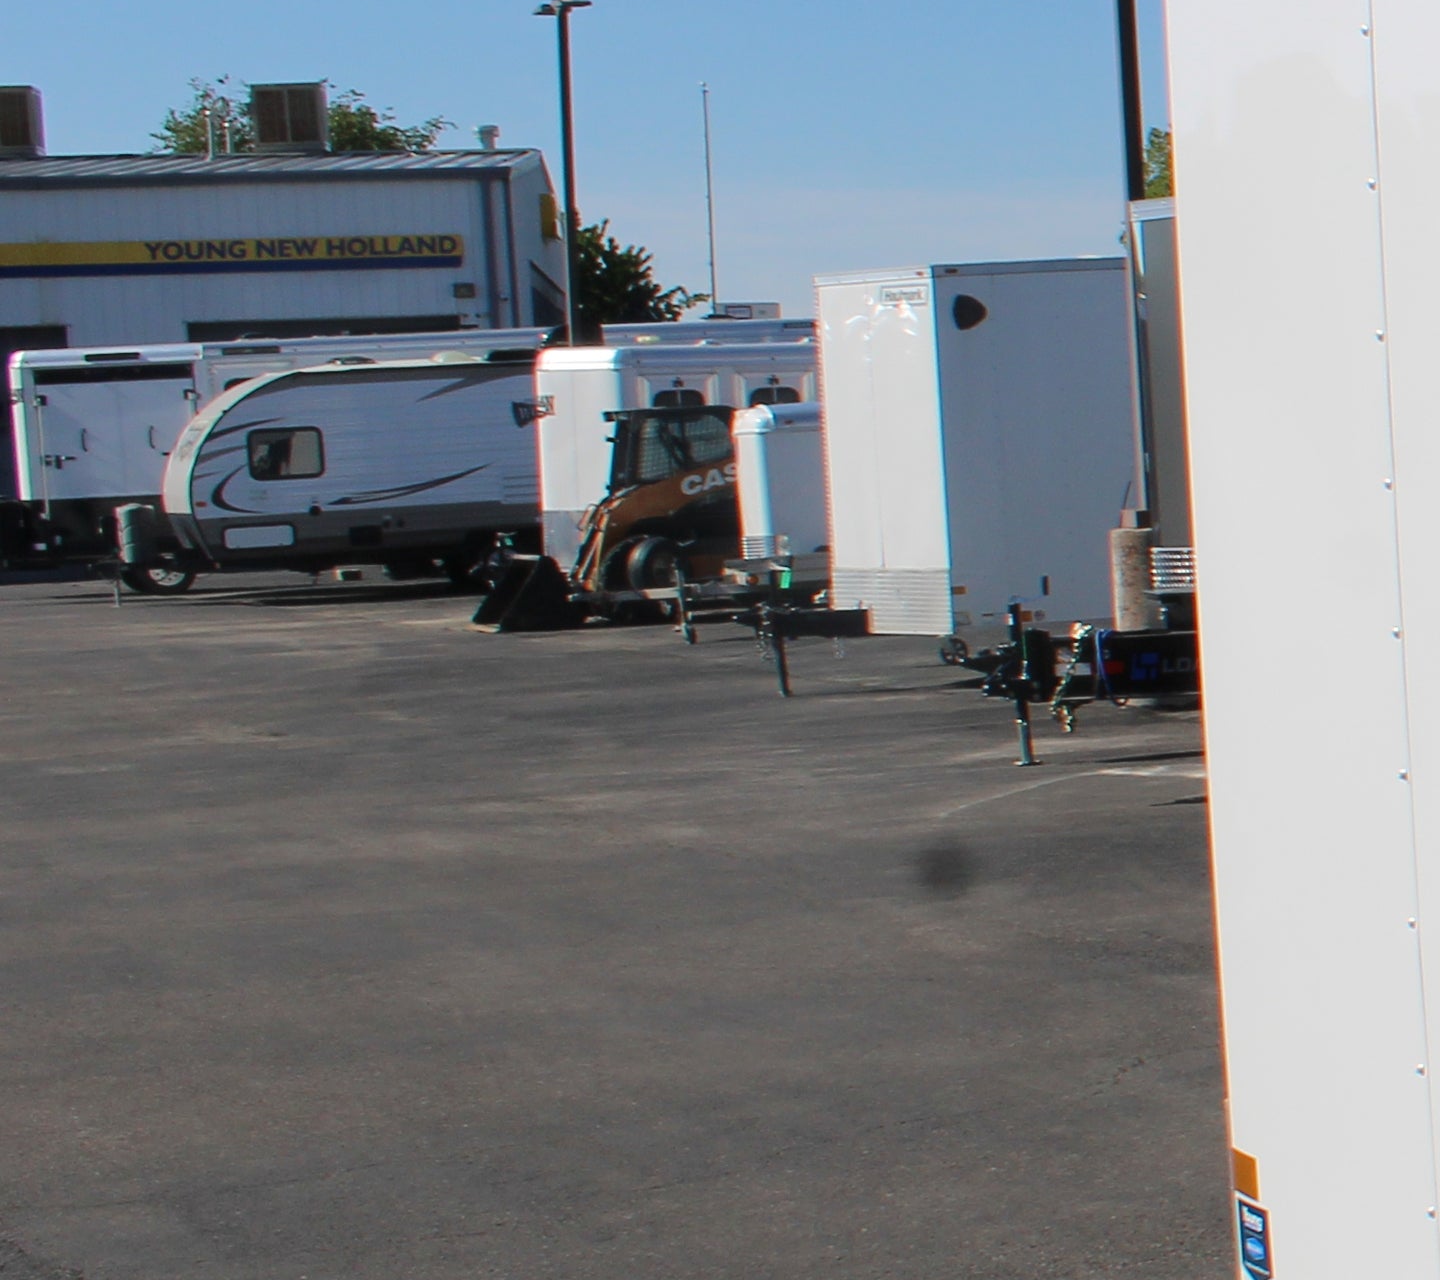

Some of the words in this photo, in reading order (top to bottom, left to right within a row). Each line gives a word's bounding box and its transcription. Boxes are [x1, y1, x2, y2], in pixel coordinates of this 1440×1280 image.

[144, 241, 246, 261] YOUNG
[255, 238, 320, 258] NEW
[325, 235, 457, 256] HOLLAND
[681, 463, 737, 496] CAS
